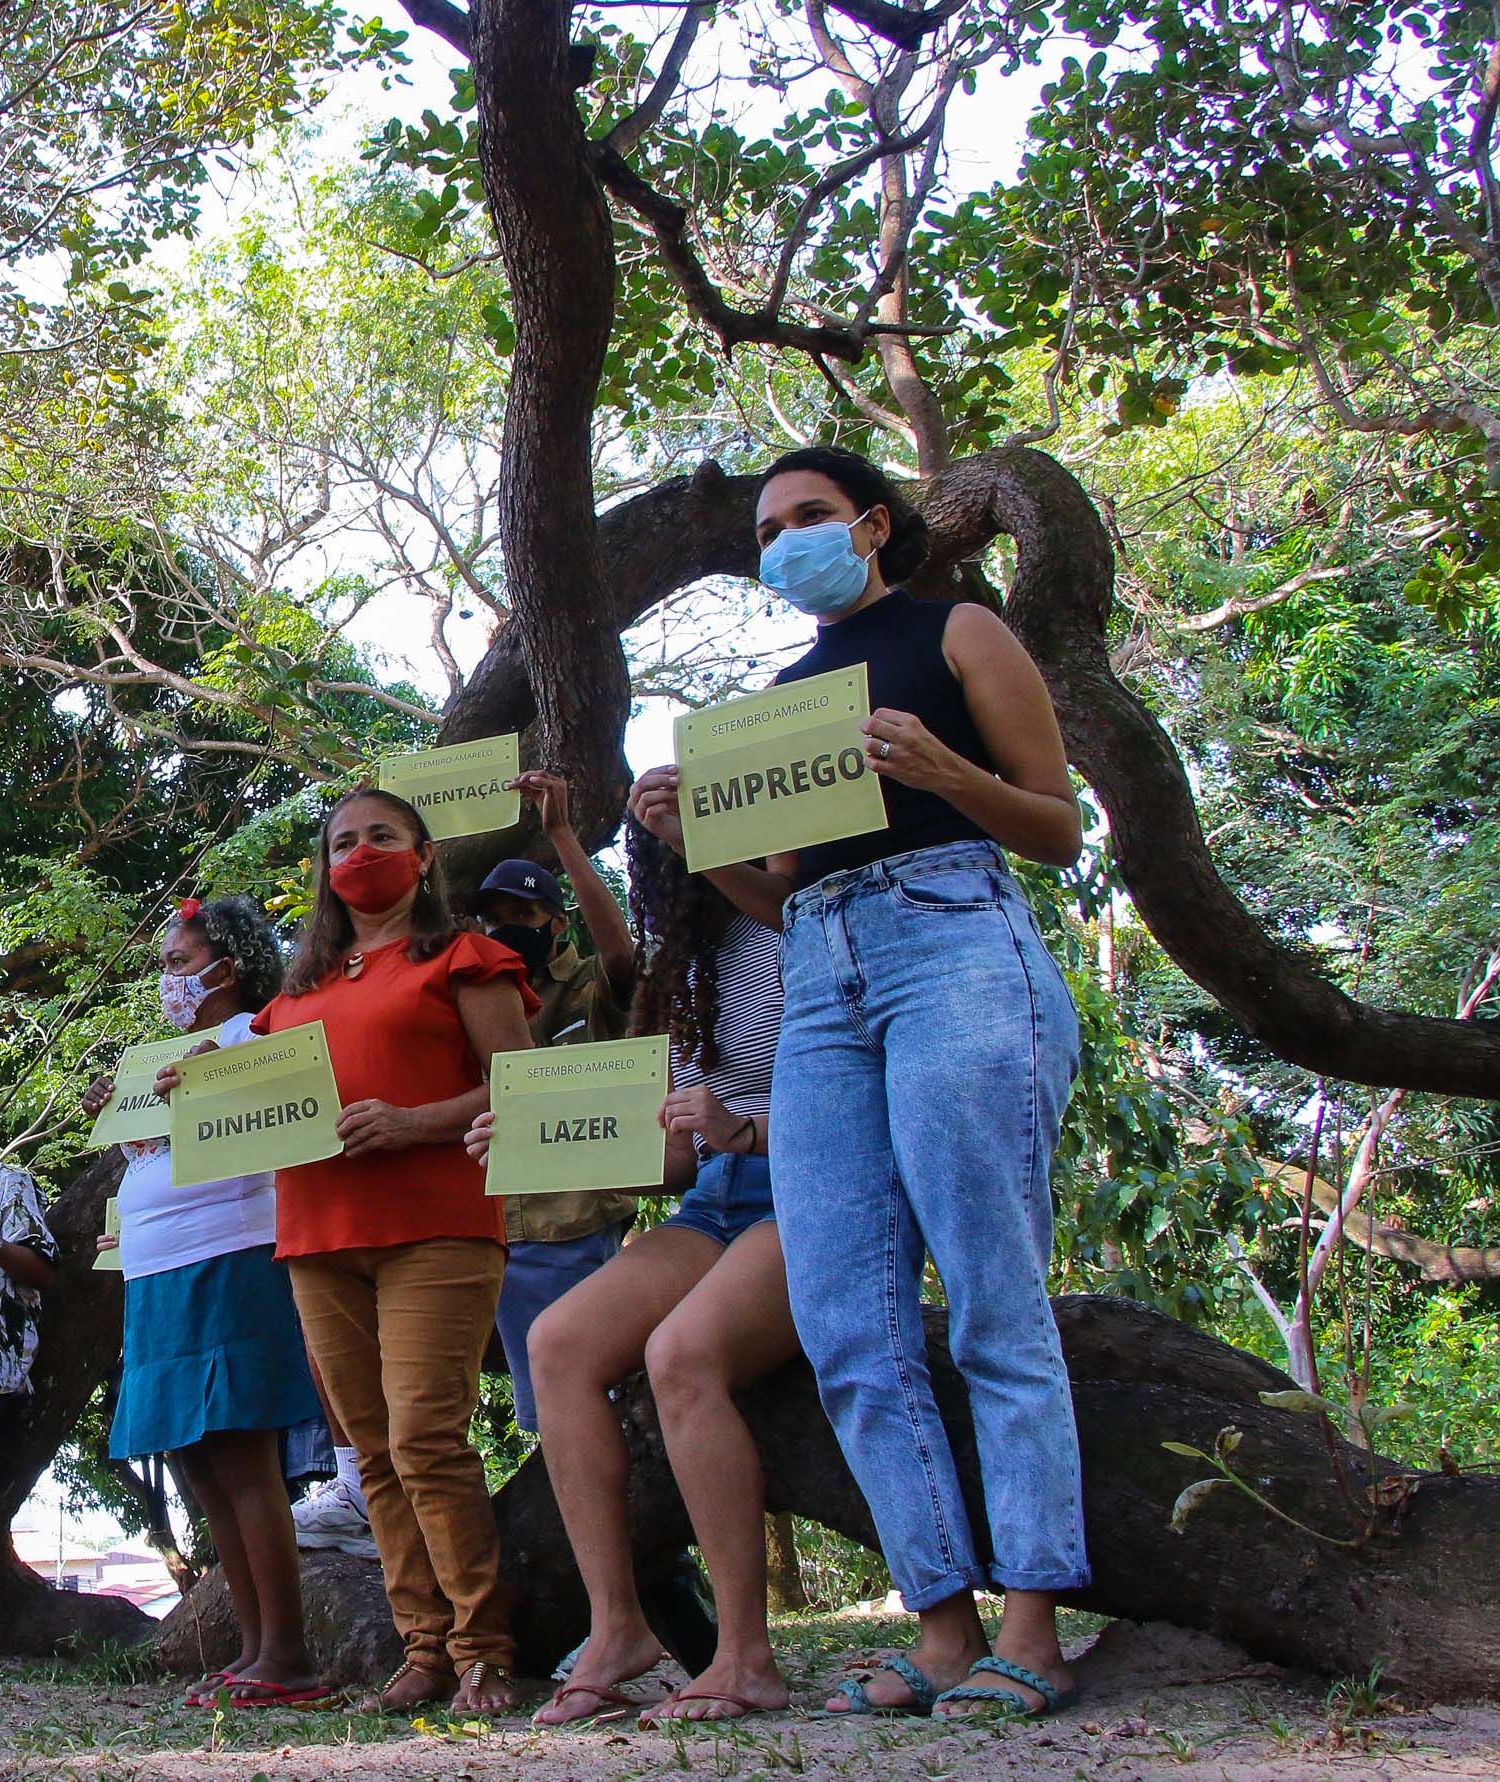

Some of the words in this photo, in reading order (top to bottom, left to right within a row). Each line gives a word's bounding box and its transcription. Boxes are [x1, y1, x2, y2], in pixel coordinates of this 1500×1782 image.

[711, 710, 770, 737] SETEMBRO
[773, 695, 829, 720] AMARELO
[409, 757, 452, 770] SETEMBRO
[454, 749, 493, 761] AMARELO
[411, 779, 513, 808] IMENTAÇÃO
[691, 747, 866, 819] EMPREGO
[203, 1060, 251, 1081] SETEMBRO
[253, 1047, 297, 1068] AMARELO
[527, 1063, 582, 1079] SETEMBRO
[585, 1058, 635, 1073] AMARELO
[197, 1097, 319, 1142] DINHEIRO
[540, 1116, 619, 1145] LAZER
